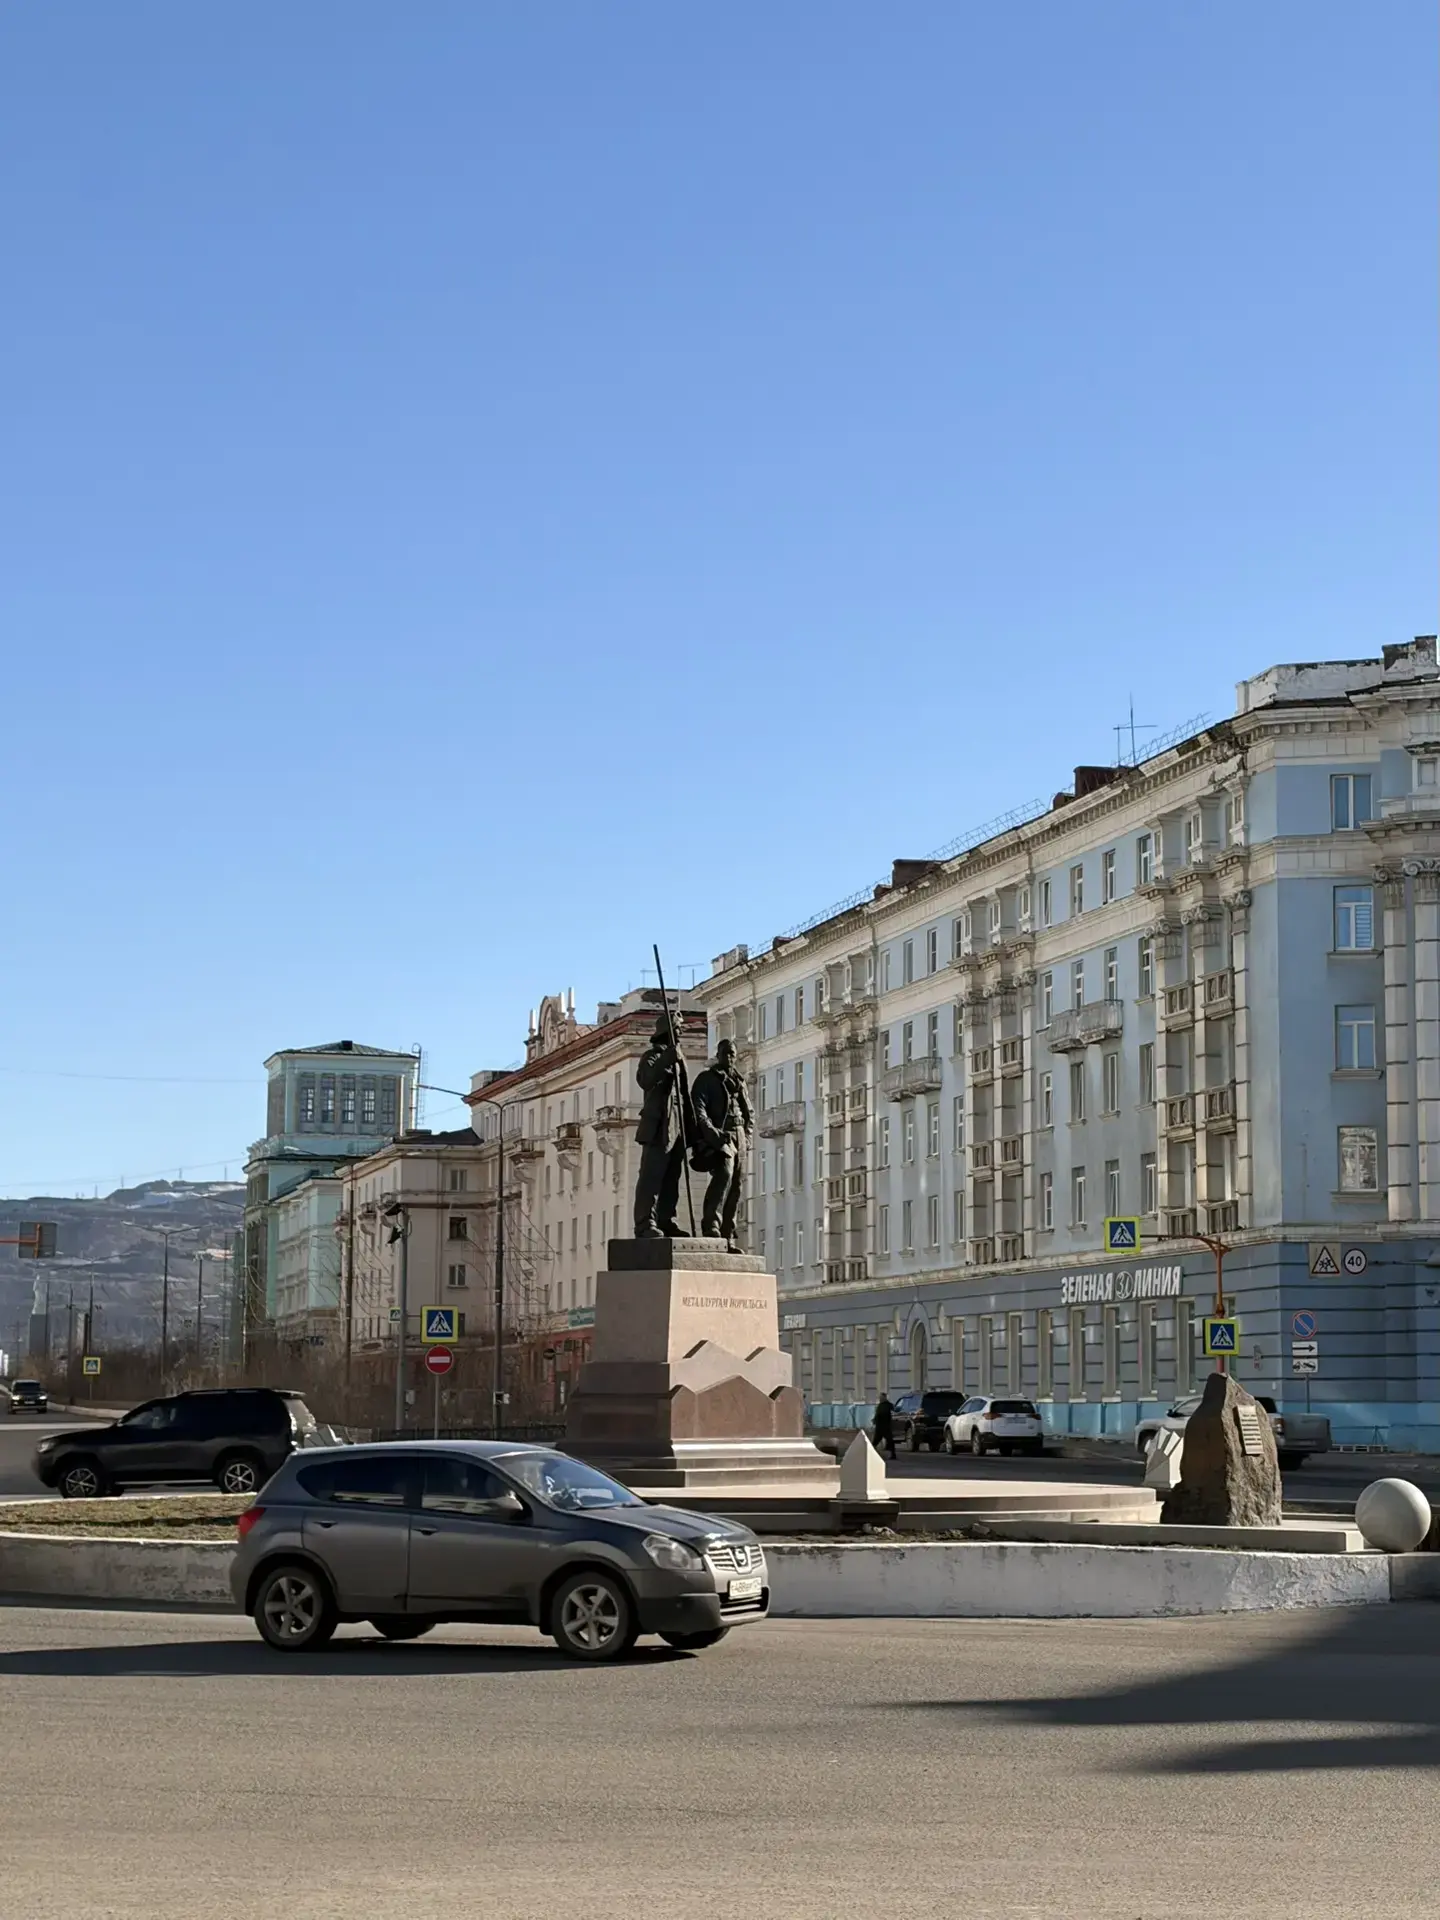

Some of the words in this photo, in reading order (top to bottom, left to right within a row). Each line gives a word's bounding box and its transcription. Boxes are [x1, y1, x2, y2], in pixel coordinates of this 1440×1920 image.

[1347, 1256, 1362, 1266] 40
[1061, 1273, 1114, 1304] ЗЕЛЕНАЯ
[1132, 1266, 1181, 1298] ЛИНИЯ
